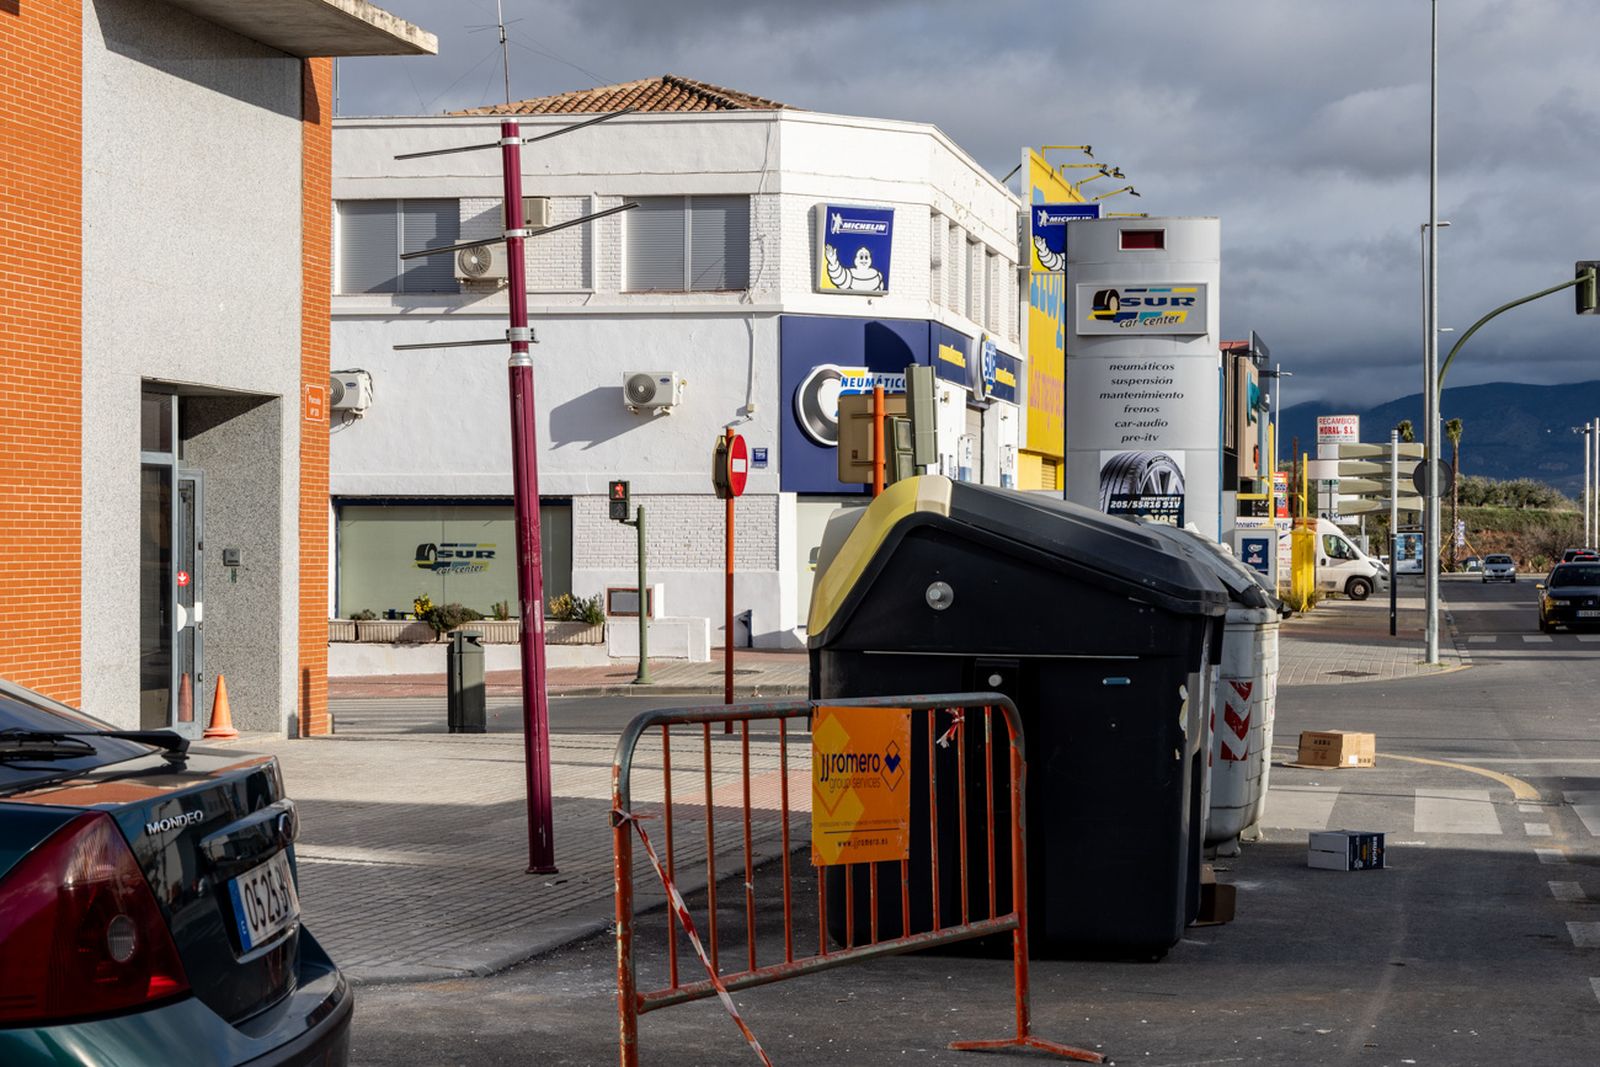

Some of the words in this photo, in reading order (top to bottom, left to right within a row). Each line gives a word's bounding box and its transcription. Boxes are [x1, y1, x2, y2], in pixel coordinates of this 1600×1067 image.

[842, 221, 886, 231] MICHELIN
[1120, 297, 1196, 307] SUR
[1120, 319, 1138, 328] car
[1143, 315, 1181, 327] center
[1109, 361, 1175, 371] neumáticos
[1111, 376, 1174, 387] suspensión
[1099, 390, 1185, 400] mantenimiento
[1124, 404, 1161, 413] frenos
[1114, 418, 1169, 428] car-audio
[1319, 417, 1356, 425] RECAMBIOS
[1121, 433, 1160, 444] pre-itv
[1110, 500, 1161, 509] 205/55R16
[1162, 500, 1181, 509] 91V
[437, 550, 496, 559] SUR
[436, 567, 451, 575] car
[454, 565, 484, 573] center
[851, 776, 881, 789] services
[146, 810, 204, 835] MONDEO
